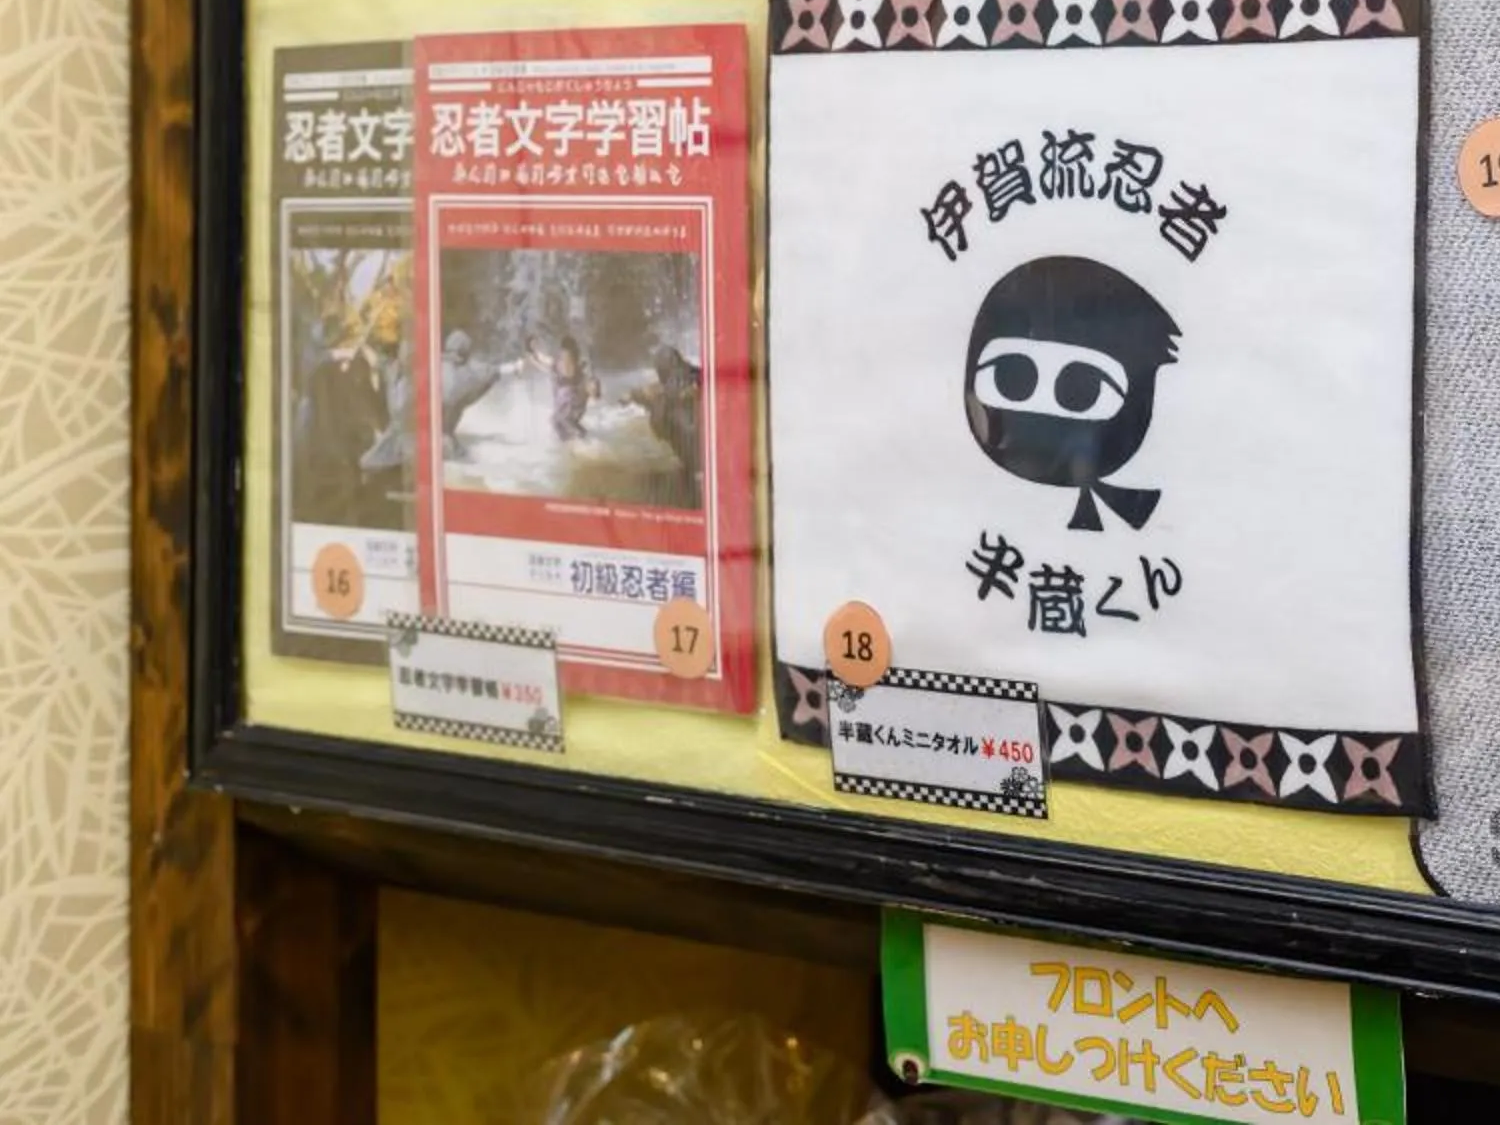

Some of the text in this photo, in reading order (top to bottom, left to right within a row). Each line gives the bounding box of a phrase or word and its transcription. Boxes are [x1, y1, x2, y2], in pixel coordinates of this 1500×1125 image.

[429, 96, 711, 158] 忍者文字学習帖
[920, 128, 1228, 263] 伊賀流忍者
[327, 567, 351, 597] 16
[965, 530, 1183, 638] 半蔵くん
[670, 625, 699, 655] 17
[842, 630, 873, 661] 18
[1030, 961, 1239, 1034] フロントへ
[946, 1010, 1346, 1117] お申しつけください
